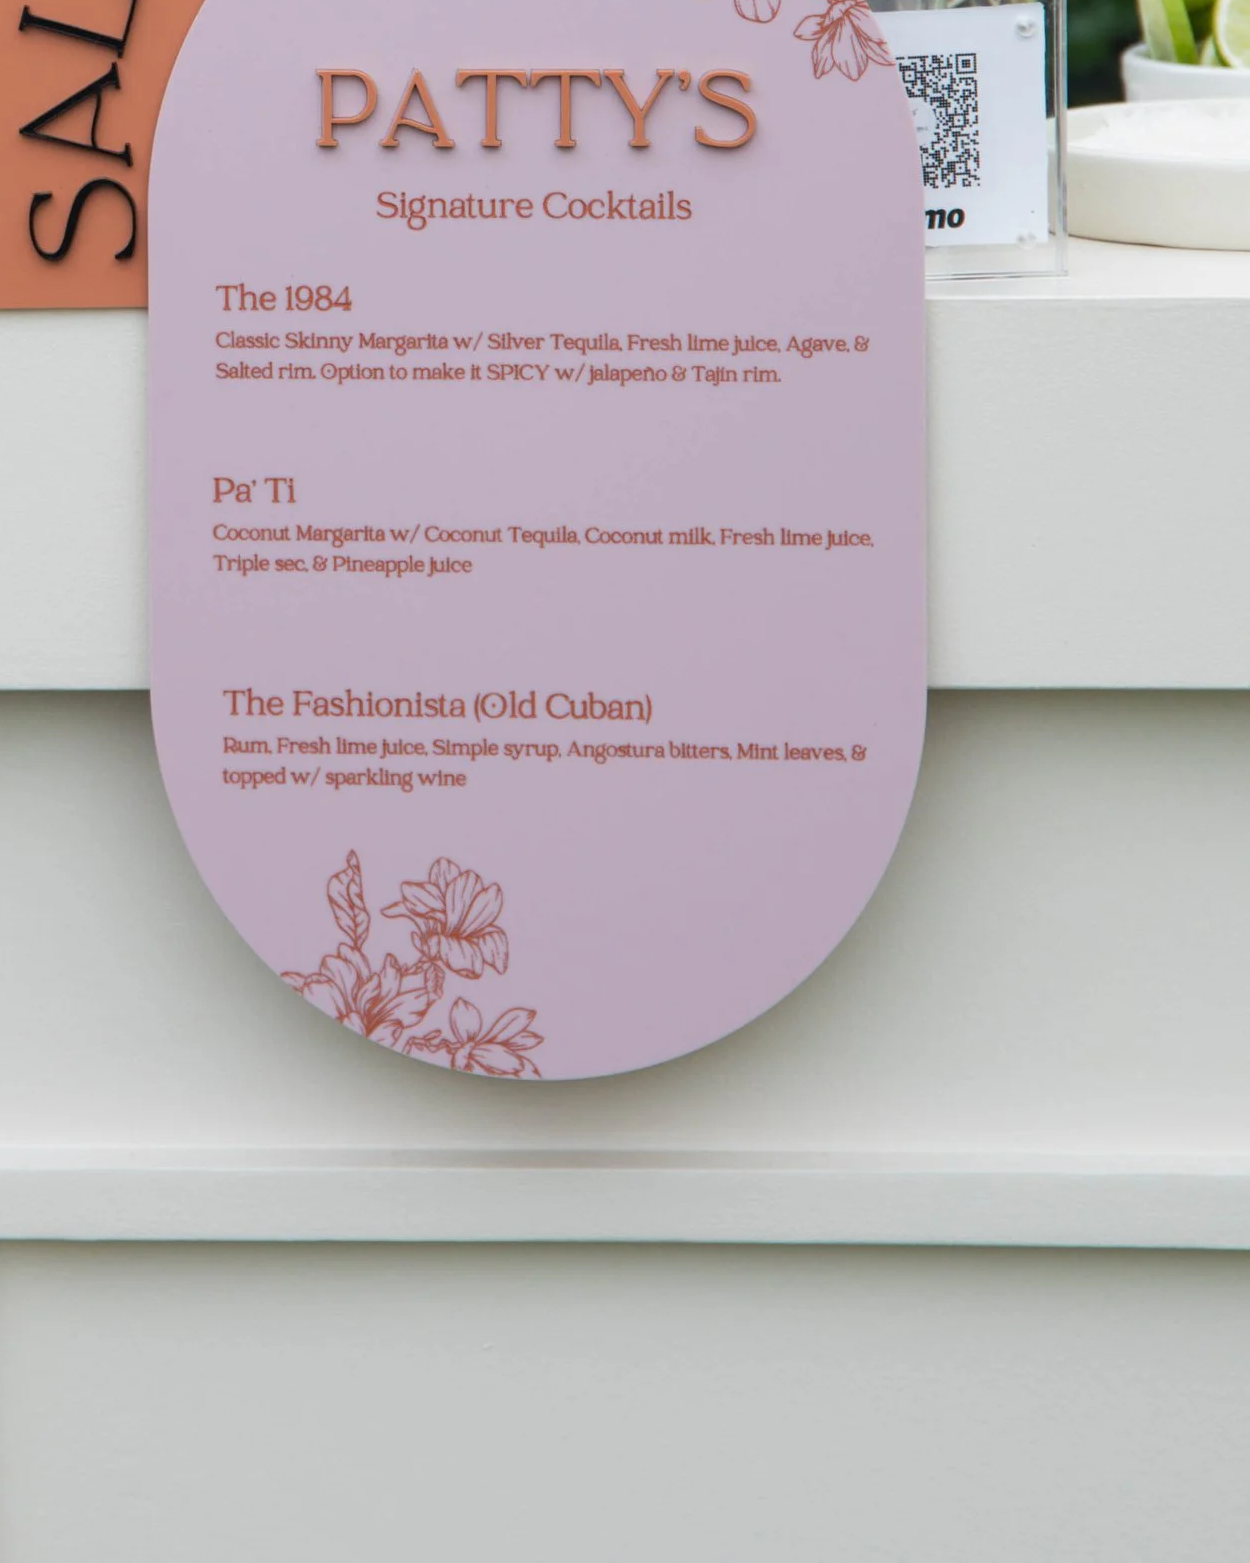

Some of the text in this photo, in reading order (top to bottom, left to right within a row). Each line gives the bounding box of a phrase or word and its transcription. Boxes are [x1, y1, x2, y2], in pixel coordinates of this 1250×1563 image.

[314, 67, 760, 154] PATTY'S
[375, 190, 695, 233] Signature Cocktails
[215, 283, 354, 313] The 1984
[215, 330, 281, 350] Classic
[284, 331, 353, 356] Skinny
[358, 331, 450, 357] Margarita
[453, 334, 482, 350] w/
[488, 332, 546, 351] Silver
[550, 332, 623, 356] Tequila,
[627, 332, 683, 353] Fresh
[687, 331, 730, 354] lime
[733, 336, 782, 358] juice,
[854, 334, 870, 355] &
[215, 360, 274, 381] Salted
[278, 363, 317, 381] rim.
[320, 362, 386, 387] Option
[389, 363, 409, 382] to
[412, 362, 466, 382] make
[470, 364, 483, 382] it
[487, 362, 550, 382] SPICY
[554, 364, 587, 382] w/
[586, 363, 669, 388] jalapeño
[671, 364, 688, 383] &
[743, 368, 779, 384] rim.
[263, 477, 296, 507] Ti
[212, 523, 873, 551] Coconut Margarita w/ Coconut Tequila, Coconut milk, Fresh lime juice,
[214, 553, 474, 579] Triple sec, & Pineapple juice
[222, 687, 654, 725] The Fashionista (Old Cuban)
[222, 735, 867, 763] Rum, Fresh lime juice, Simple syrup, Angostura bitters, Mint leaves, &
[222, 767, 467, 795] topped w/ sparkling wine
